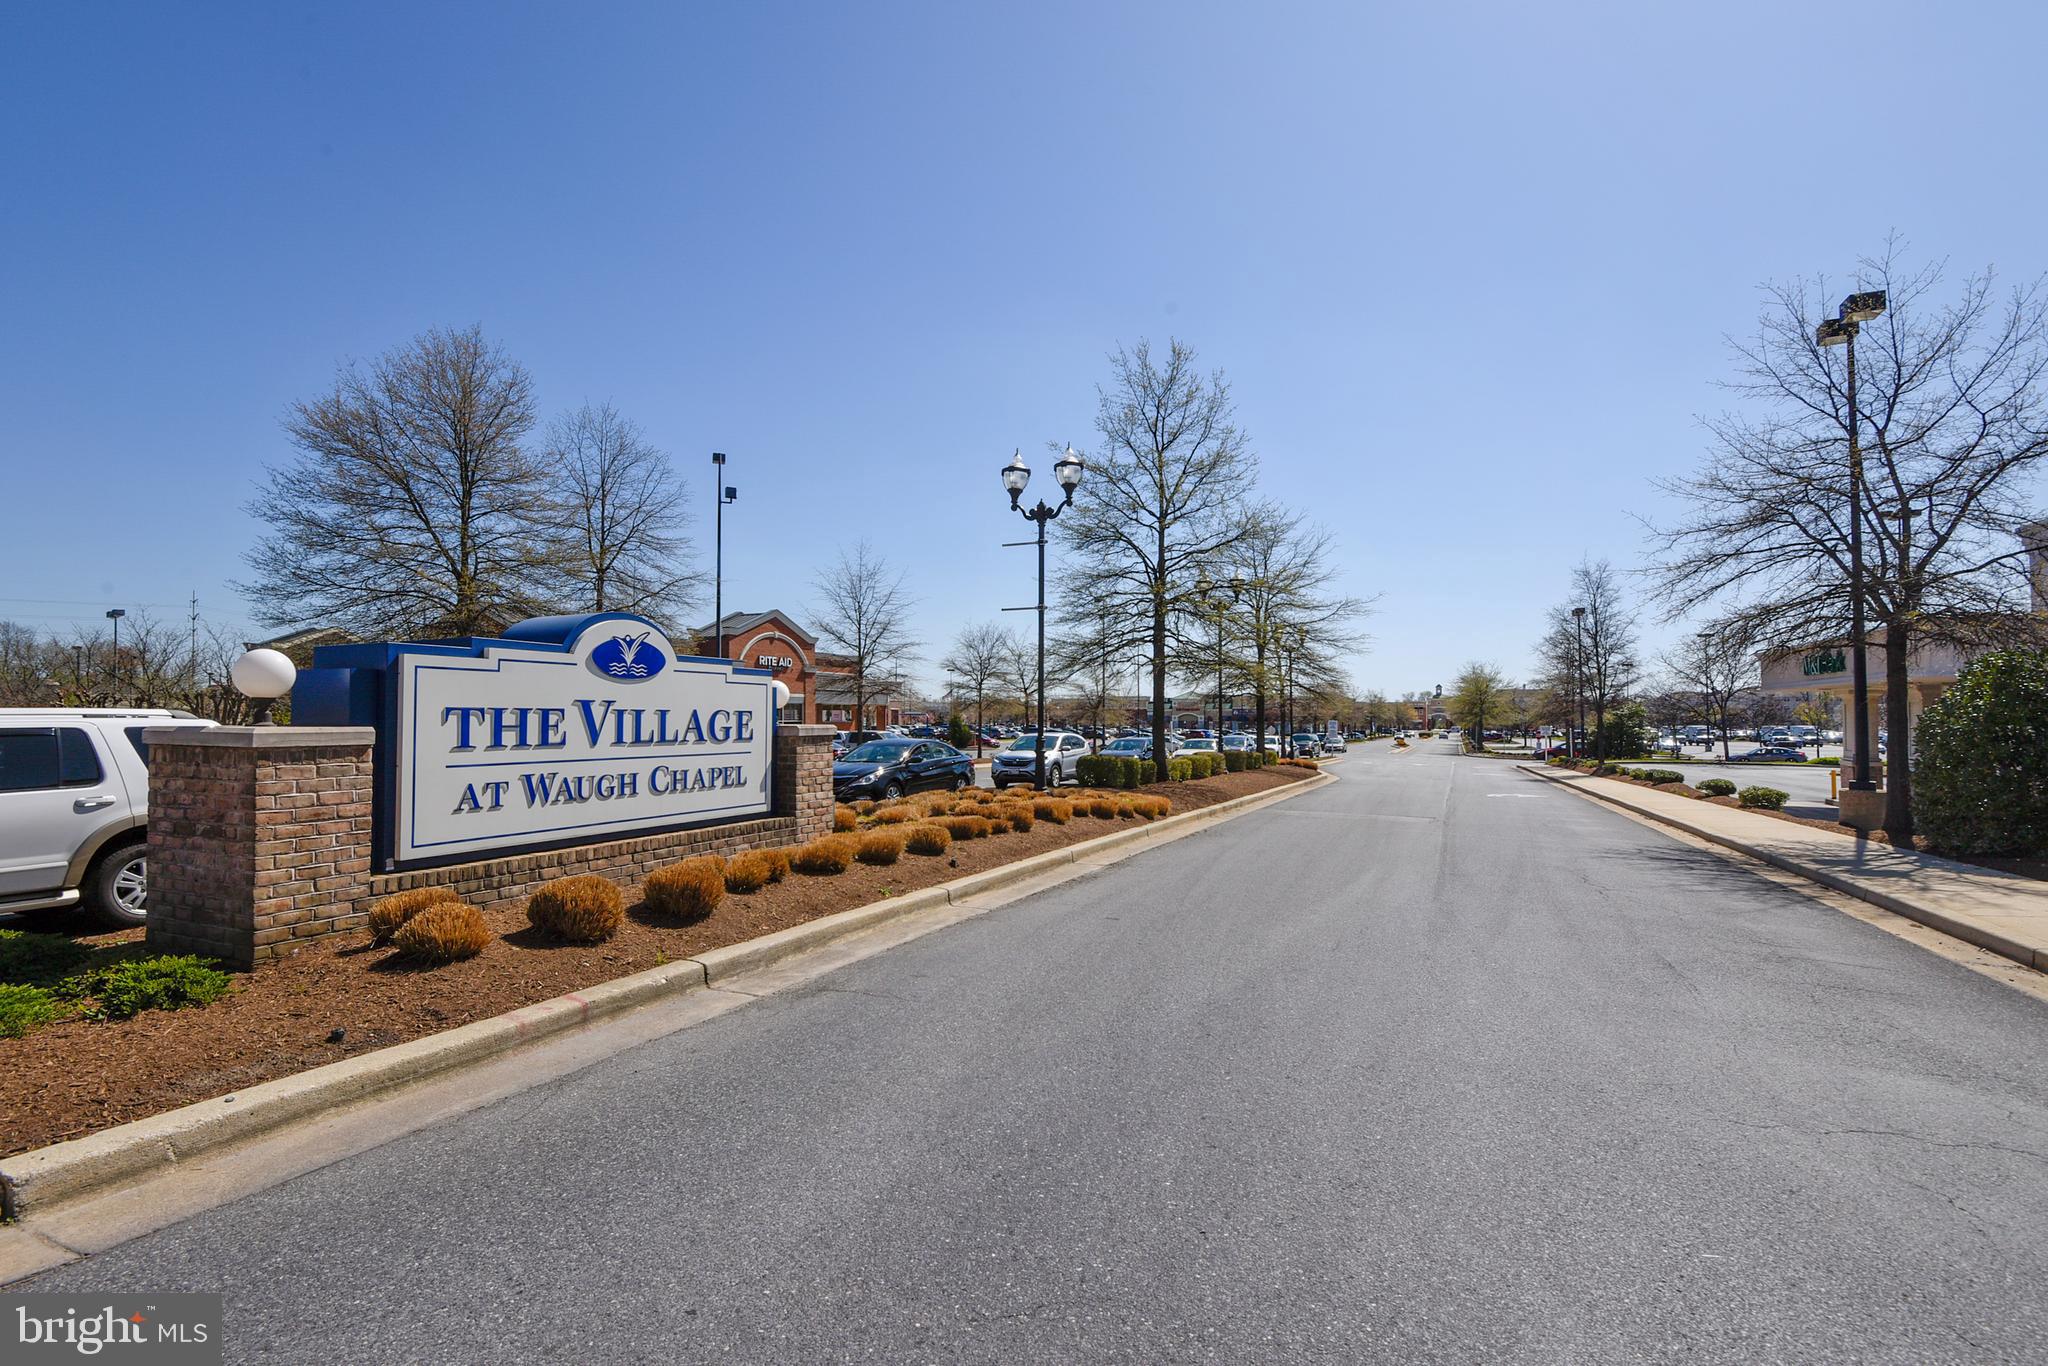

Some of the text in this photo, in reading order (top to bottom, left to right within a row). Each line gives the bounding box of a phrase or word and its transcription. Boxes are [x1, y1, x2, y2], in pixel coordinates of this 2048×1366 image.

[759, 655, 793, 667] RITE AID
[441, 700, 754, 753] THE VILLAGE
[451, 765, 747, 815] AT WAUGH CHAPEL
